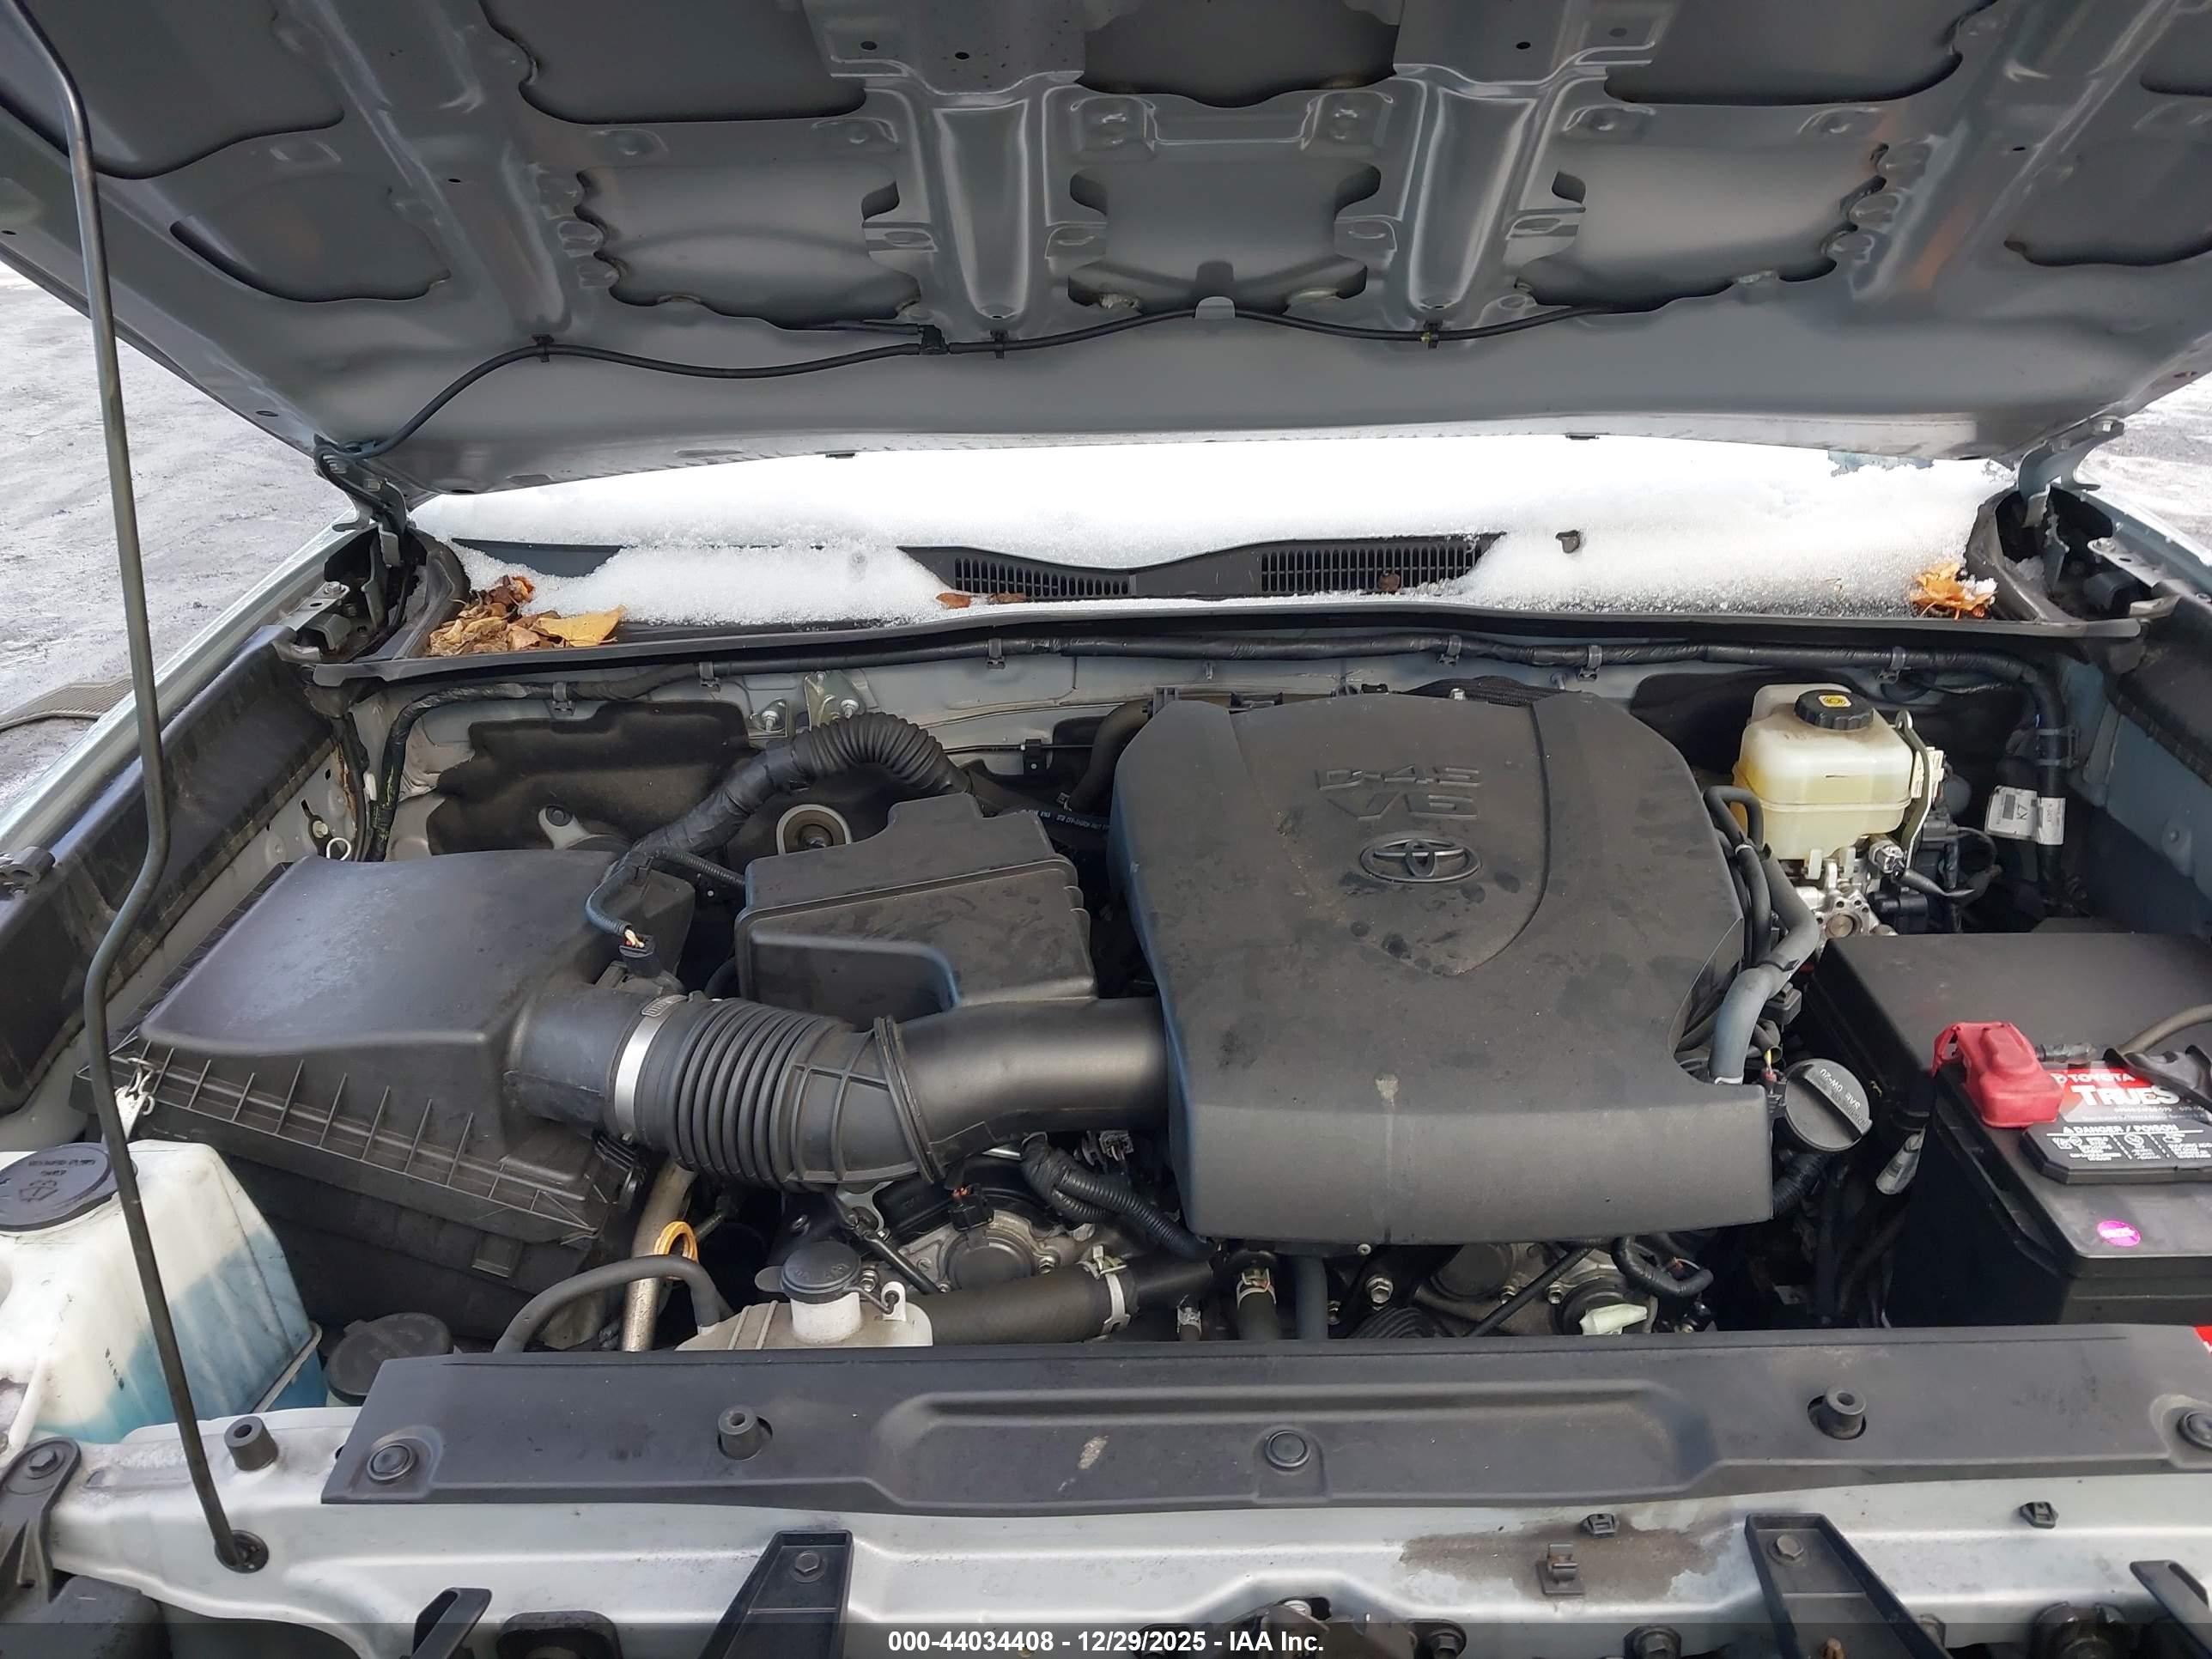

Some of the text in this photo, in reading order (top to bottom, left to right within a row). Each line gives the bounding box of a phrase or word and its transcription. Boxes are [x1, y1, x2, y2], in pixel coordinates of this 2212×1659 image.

[2067, 1073, 2136, 1083] TOYOTA
[1820, 1068, 1862, 1110] SAE 0W-20
[2074, 1125, 2124, 1134] DANGER
[2133, 1123, 2179, 1133] POISON
